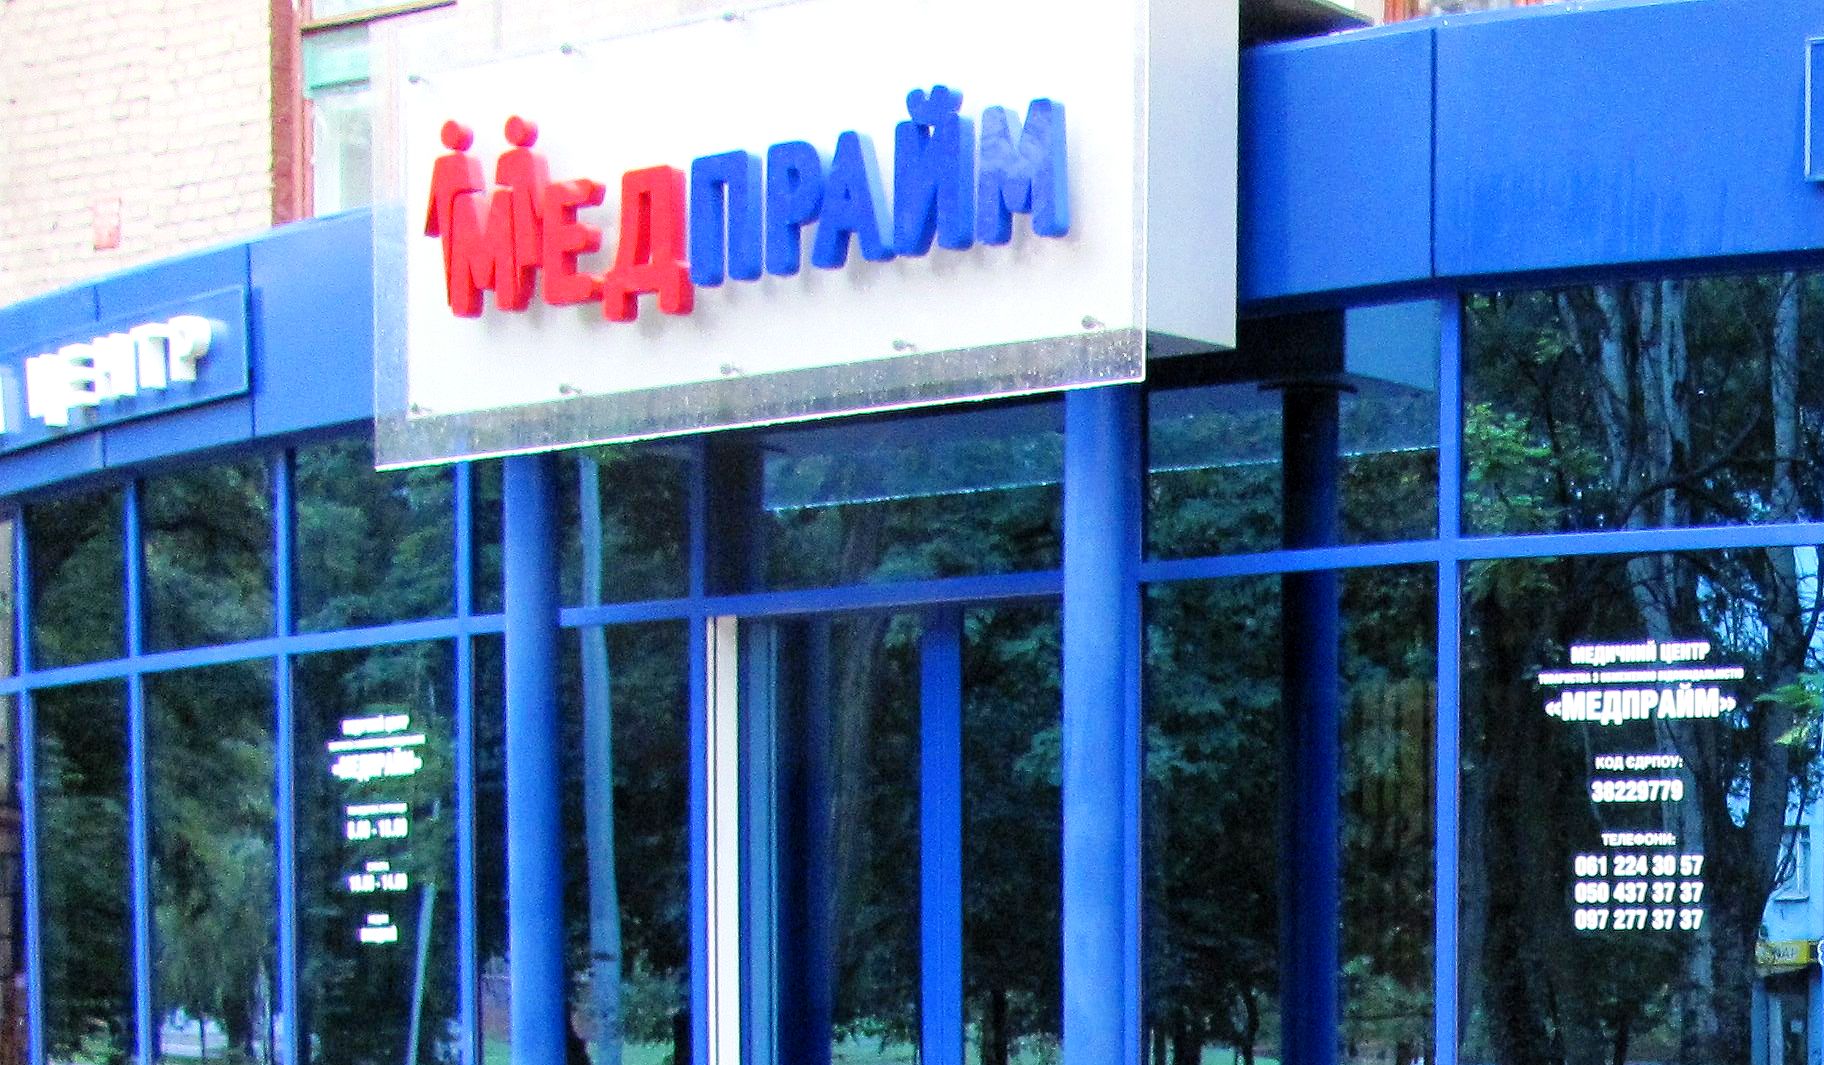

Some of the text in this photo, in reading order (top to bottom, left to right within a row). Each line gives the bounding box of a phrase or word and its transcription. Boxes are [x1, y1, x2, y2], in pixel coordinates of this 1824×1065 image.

[428, 84, 1071, 322] МЕДПРАЙМ
[25, 315, 213, 428] ЦЕНТР
[1570, 640, 1711, 667] МЕДИЧНИЙ ЦЕНТР
[1544, 682, 1737, 726] «МЕДПРАЙМ»
[1595, 755, 1683, 771] КОД ЄДРПОУ:
[1591, 779, 1684, 803] 38229779
[1601, 832, 1676, 847] ТЕЛЕФОНИ:
[1574, 854, 1705, 877] 061 224 30 57
[1574, 881, 1705, 904] 050 437 37 37
[1574, 908, 1705, 931] 097 277 37 37
